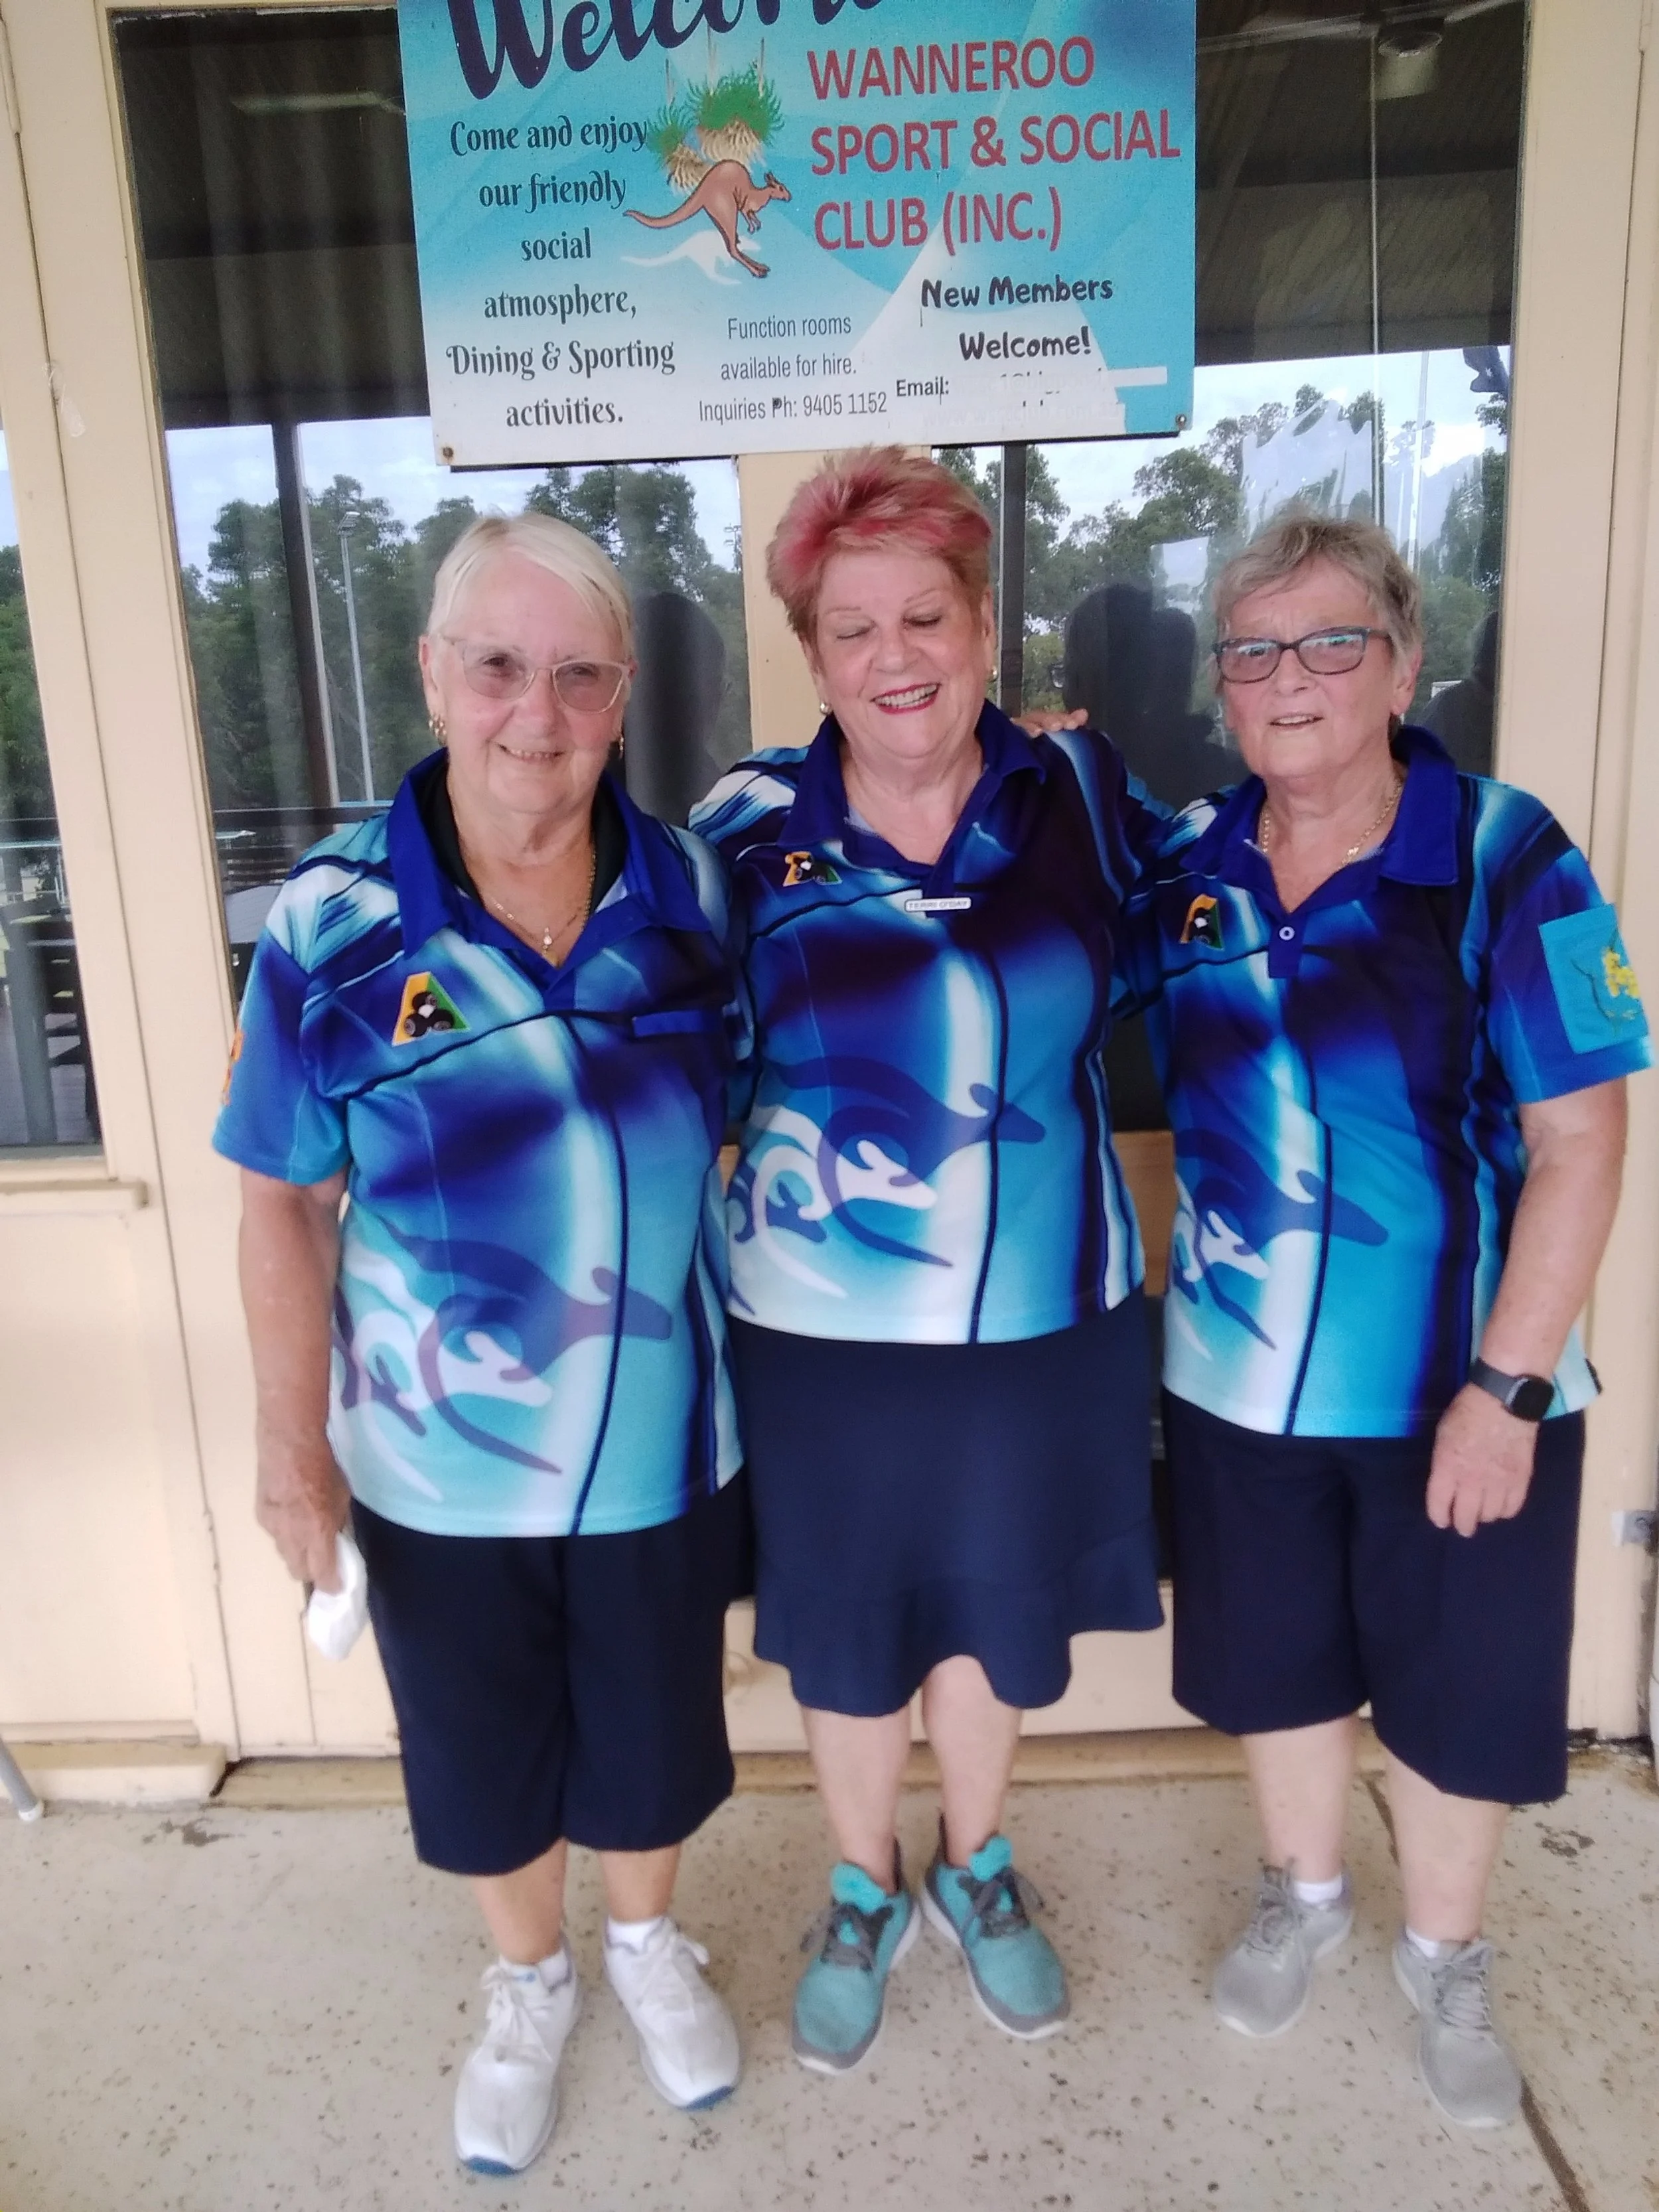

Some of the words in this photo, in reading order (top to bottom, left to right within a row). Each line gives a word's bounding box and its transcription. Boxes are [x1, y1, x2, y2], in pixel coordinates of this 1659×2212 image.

[449, 0, 883, 100] Welco
[807, 35, 1096, 100] WANNEROO
[451, 121, 520, 157] Come
[528, 115, 573, 155] and
[580, 115, 649, 153] enjoy
[810, 119, 958, 177] SPORT
[970, 115, 1007, 168] &
[1019, 108, 1181, 166] SOCIAL
[479, 182, 523, 208] our
[525, 170, 626, 214] friendly
[814, 197, 929, 251] CLUB
[942, 186, 1062, 257] (INC.)
[521, 228, 592, 262] social
[484, 284, 637, 325] atmosphere,
[921, 277, 981, 309] New
[988, 274, 1114, 307] Members
[727, 315, 796, 340] Function
[802, 316, 851, 336] rooms
[958, 325, 1092, 361] Welcome!
[446, 343, 535, 381] Dining
[541, 342, 561, 372] &
[568, 340, 676, 378] Sporting
[721, 354, 791, 381] available
[796, 354, 818, 377] for
[822, 352, 857, 376] hire.
[896, 376, 950, 397] Email:
[506, 396, 624, 427] activities.
[699, 397, 766, 425] Inquiries
[772, 397, 798, 418] Ph:
[803, 394, 843, 417] 9405
[847, 392, 888, 415] 1152
